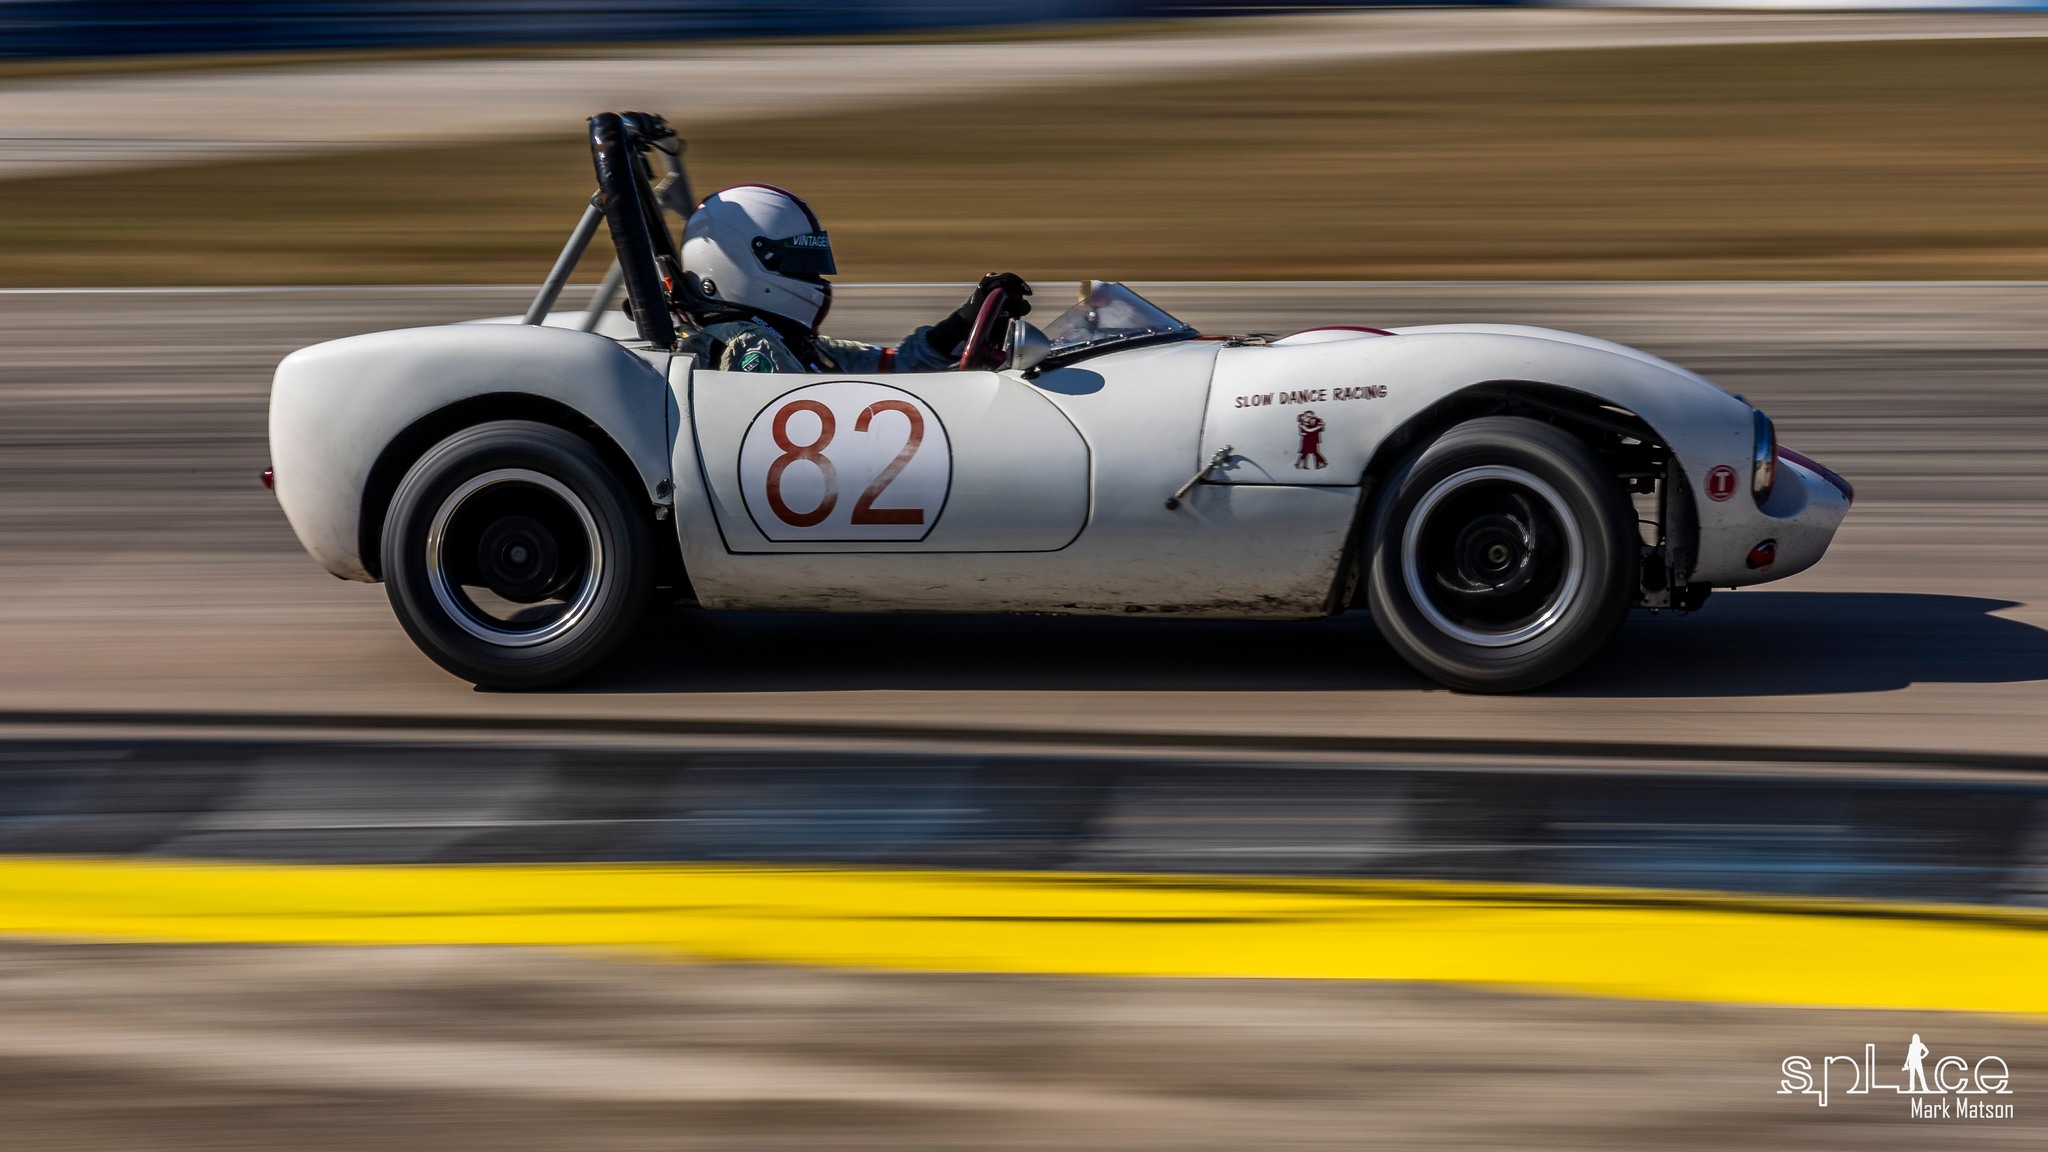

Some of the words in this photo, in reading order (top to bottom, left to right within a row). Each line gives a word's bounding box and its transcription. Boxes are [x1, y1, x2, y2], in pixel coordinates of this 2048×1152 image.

[1234, 392, 1274, 409] SLOW
[1279, 389, 1327, 405] DANCE
[1333, 385, 1388, 401] RACING
[766, 400, 925, 527] 82
